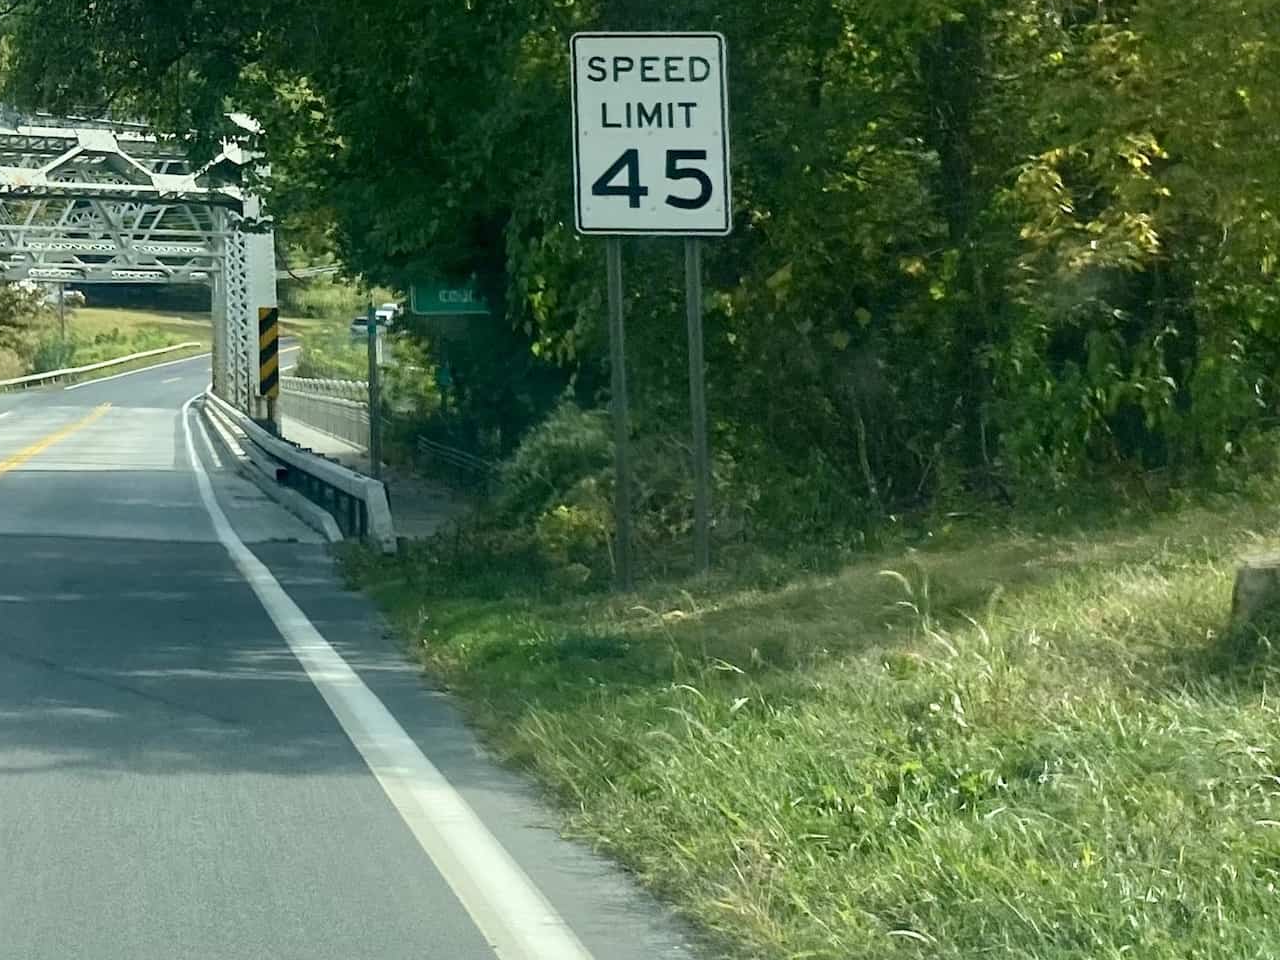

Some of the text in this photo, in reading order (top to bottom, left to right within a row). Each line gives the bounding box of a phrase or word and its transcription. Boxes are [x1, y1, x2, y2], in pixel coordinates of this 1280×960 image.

[587, 56, 711, 82] SPEED
[601, 102, 697, 128] LIMIT
[591, 148, 713, 210] 45
